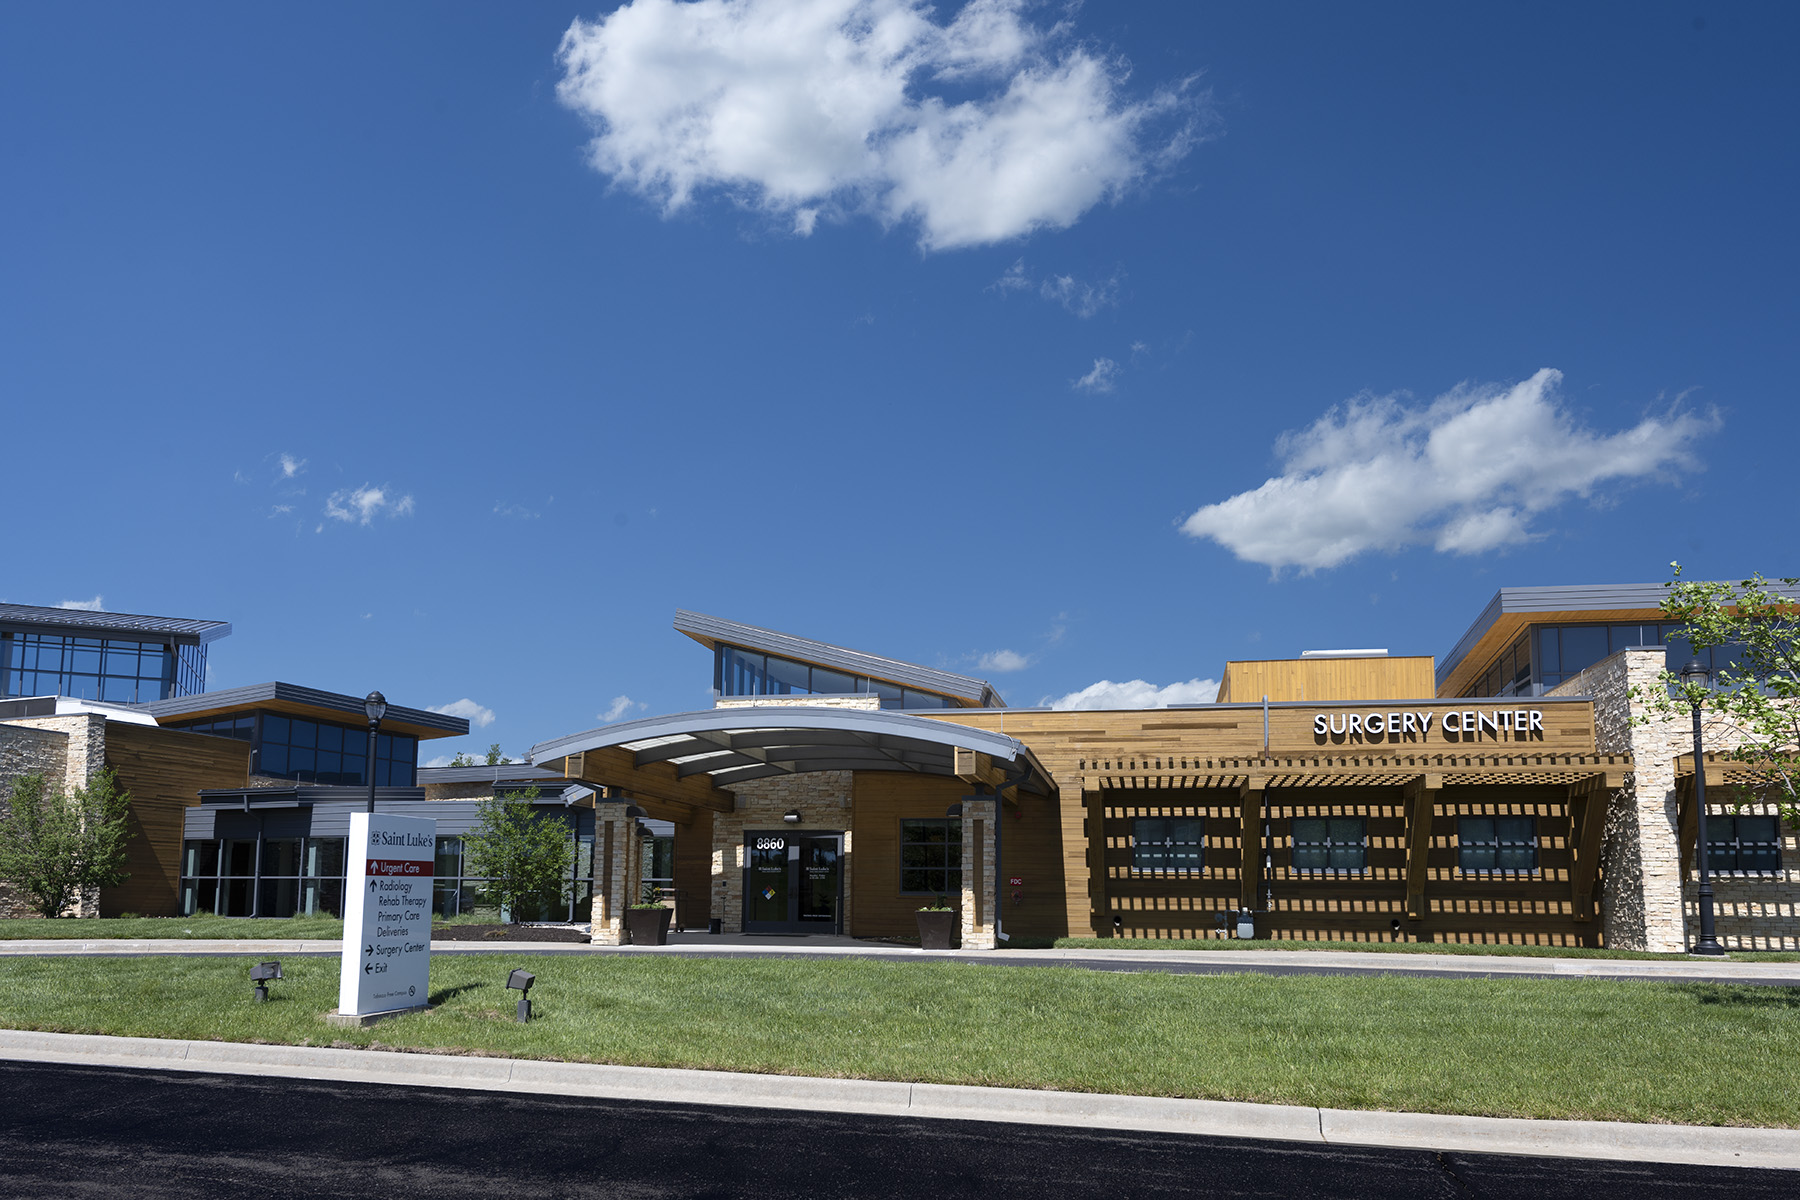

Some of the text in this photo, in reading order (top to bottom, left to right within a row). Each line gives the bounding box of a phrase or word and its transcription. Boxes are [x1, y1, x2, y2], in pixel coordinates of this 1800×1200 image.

[1313, 710, 1544, 735] SURGERY CENTER
[382, 831, 433, 847] Saint Luke's
[756, 837, 785, 850] 8860
[380, 862, 420, 876] Urgent Care
[379, 880, 413, 894] Radiology
[379, 895, 427, 908] Rehab Therapy
[377, 910, 420, 924] Primary Care
[377, 925, 409, 938] Deliveries
[376, 942, 425, 958] Surgery Center
[375, 962, 388, 974] Exit
